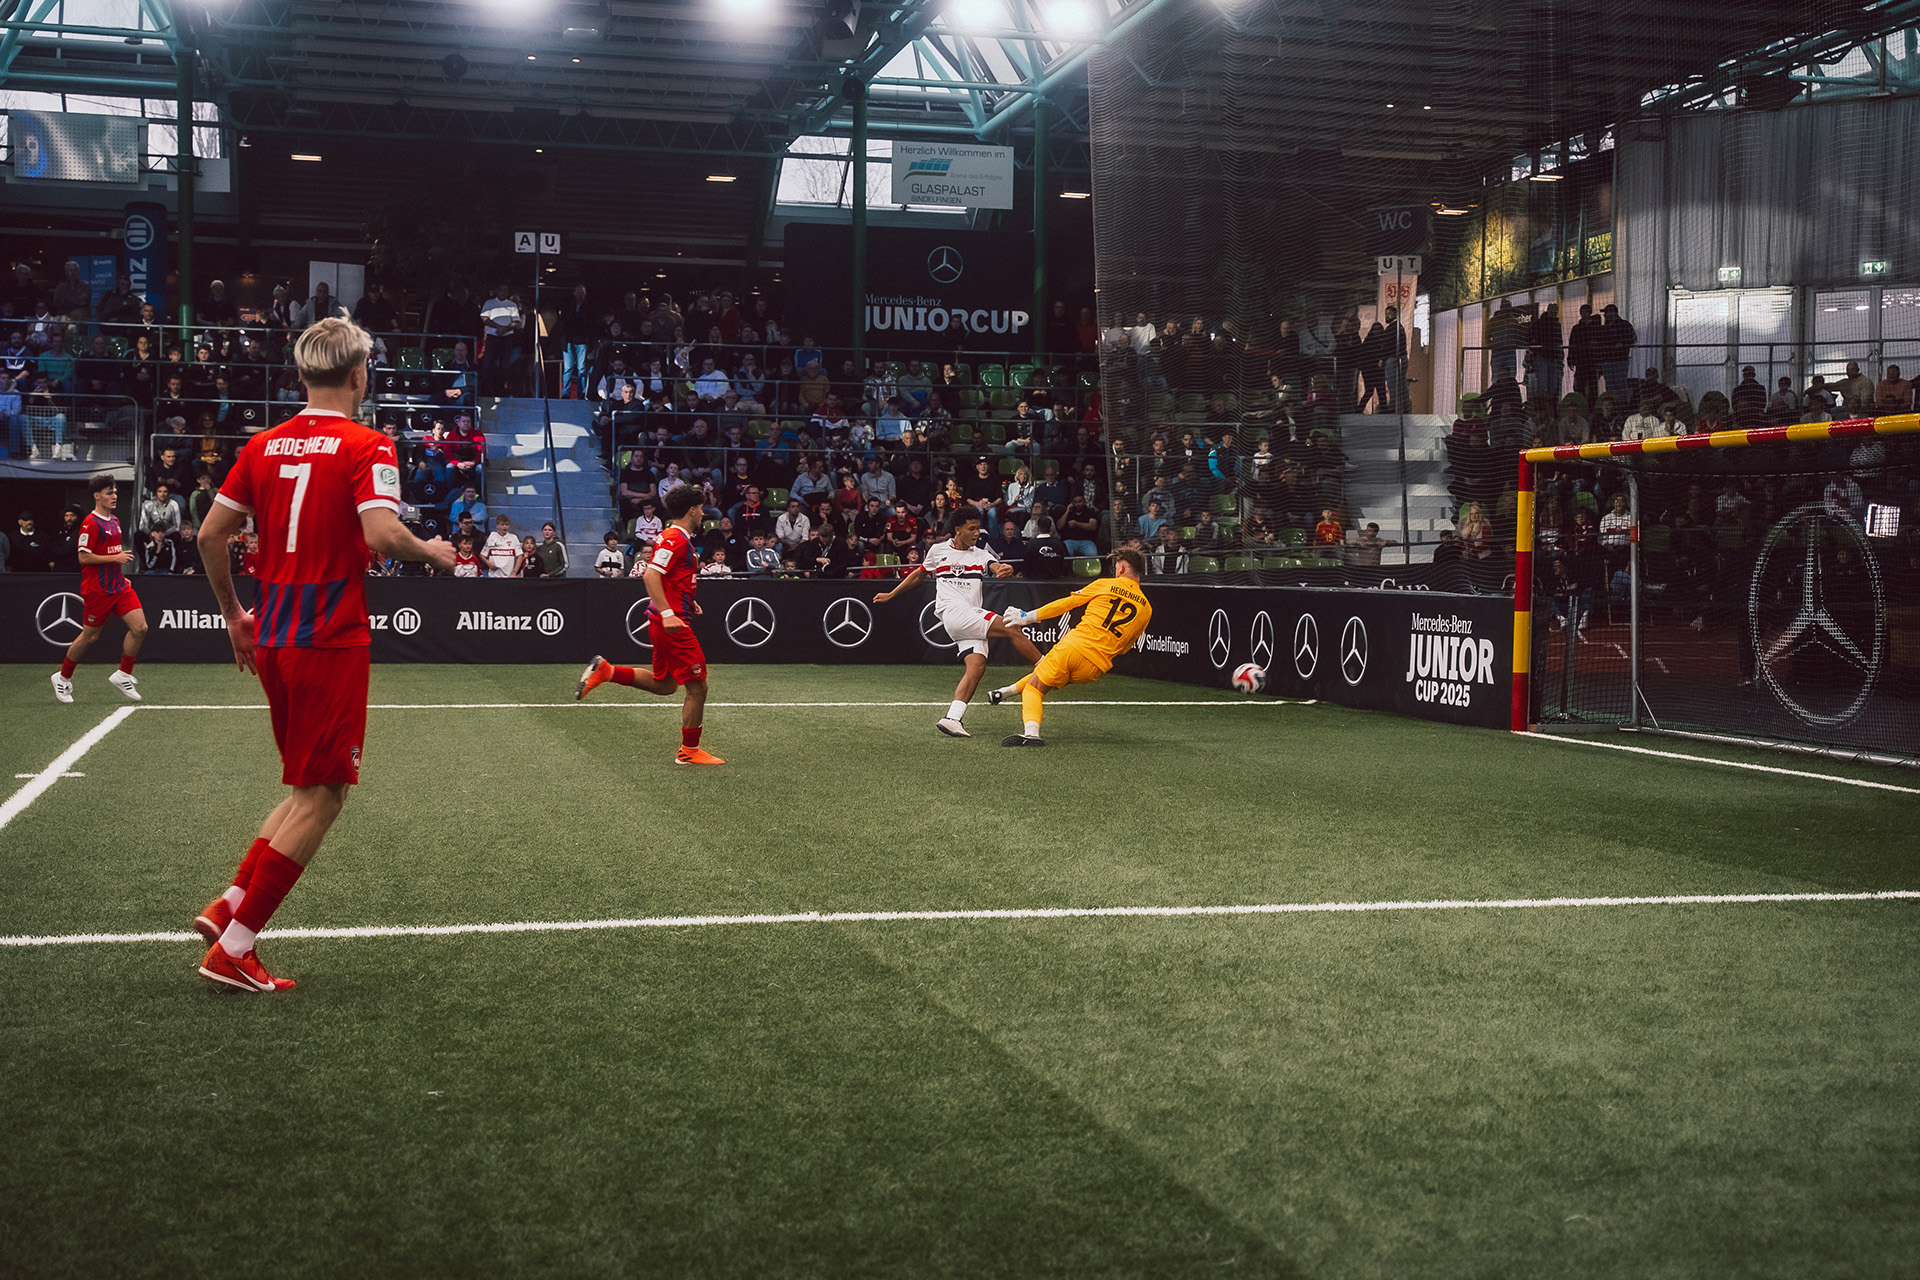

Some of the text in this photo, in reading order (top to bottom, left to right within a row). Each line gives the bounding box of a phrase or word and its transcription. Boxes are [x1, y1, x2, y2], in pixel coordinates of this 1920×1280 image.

[900, 145, 1006, 159] Herzlich Willkommen im
[911, 183, 986, 196] GLASPALAST
[911, 195, 962, 204] SINDELFINGEN
[1378, 211, 1412, 231] WC
[519, 234, 531, 246] A
[545, 235, 555, 247] U
[1383, 257, 1393, 269] U
[1408, 257, 1417, 269] T
[866, 294, 942, 306] Mercedes-Benz
[264, 436, 342, 457] HEIDEHEIM
[279, 463, 312, 553] 7
[1110, 586, 1147, 607] HEIDENHEIM
[159, 609, 228, 629] Allian
[456, 611, 532, 631] Allianz
[1101, 597, 1137, 638] 12
[1411, 613, 1472, 634] Mercedes-Benz
[1021, 626, 1056, 643] Stadt
[1146, 634, 1189, 657] Sindelfingen
[1406, 634, 1495, 684] JUNIOR
[1415, 679, 1470, 708] CUP 2025
